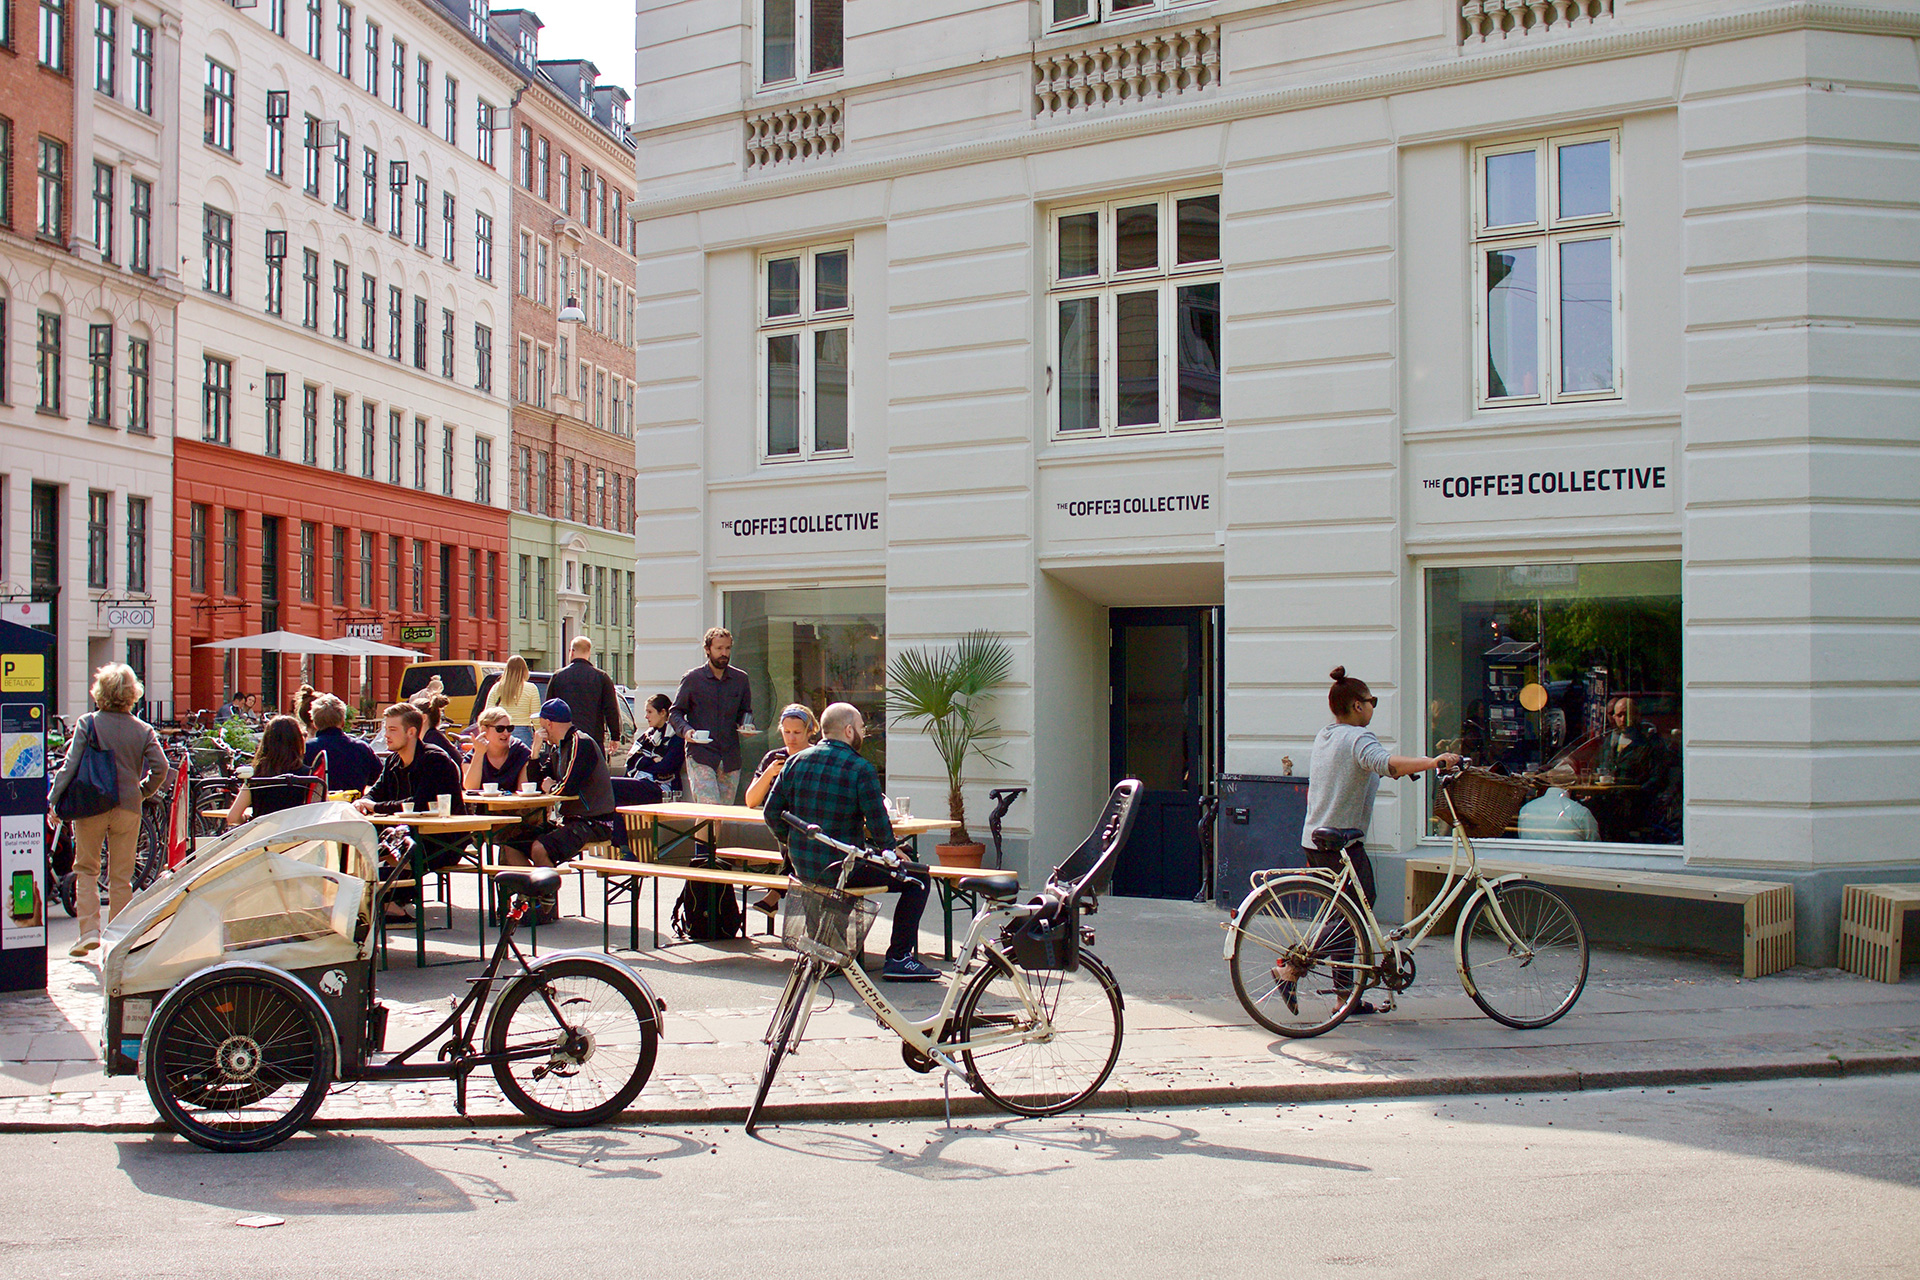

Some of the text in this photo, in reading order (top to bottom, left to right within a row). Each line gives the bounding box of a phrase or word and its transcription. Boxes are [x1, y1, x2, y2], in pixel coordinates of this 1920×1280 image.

[1423, 466, 1666, 498] THE COFFEE COLLECTIVE
[1069, 499, 1121, 516] COFFEE
[1123, 494, 1210, 514] COLLECTIVE
[721, 512, 879, 537] THE COFFEE COLLECTIVE
[109, 610, 153, 625] GRØD
[5, 661, 15, 676] P
[5, 679, 36, 687] BETALING
[4, 830, 41, 839] ParkMan
[849, 965, 891, 1015] winther
